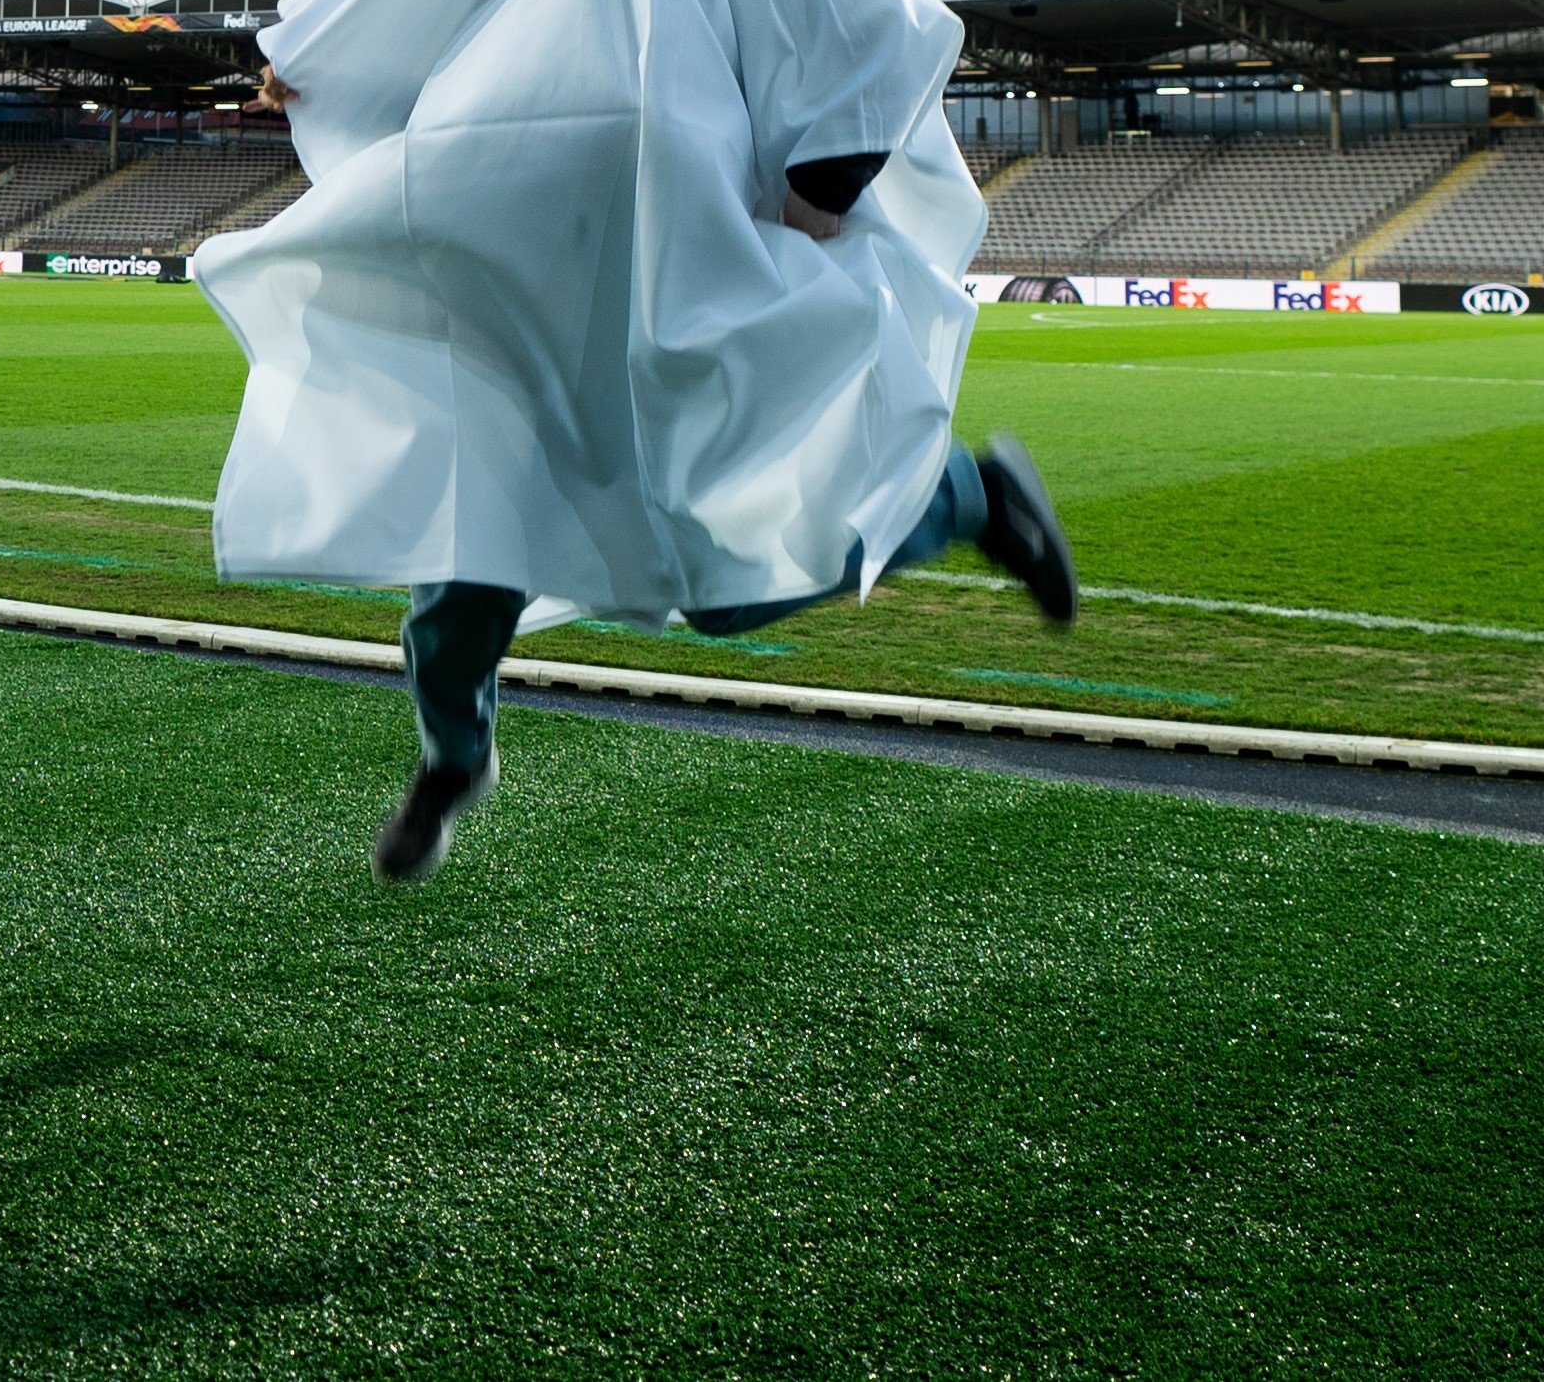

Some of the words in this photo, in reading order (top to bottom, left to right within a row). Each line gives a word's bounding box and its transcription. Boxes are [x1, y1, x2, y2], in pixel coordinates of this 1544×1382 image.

[2, 20, 43, 32] EUROPA
[45, 19, 87, 31] LEAGUE
[47, 255, 161, 276] enterprise
[1125, 278, 1208, 309] FedEx
[1273, 281, 1363, 312] FedEx
